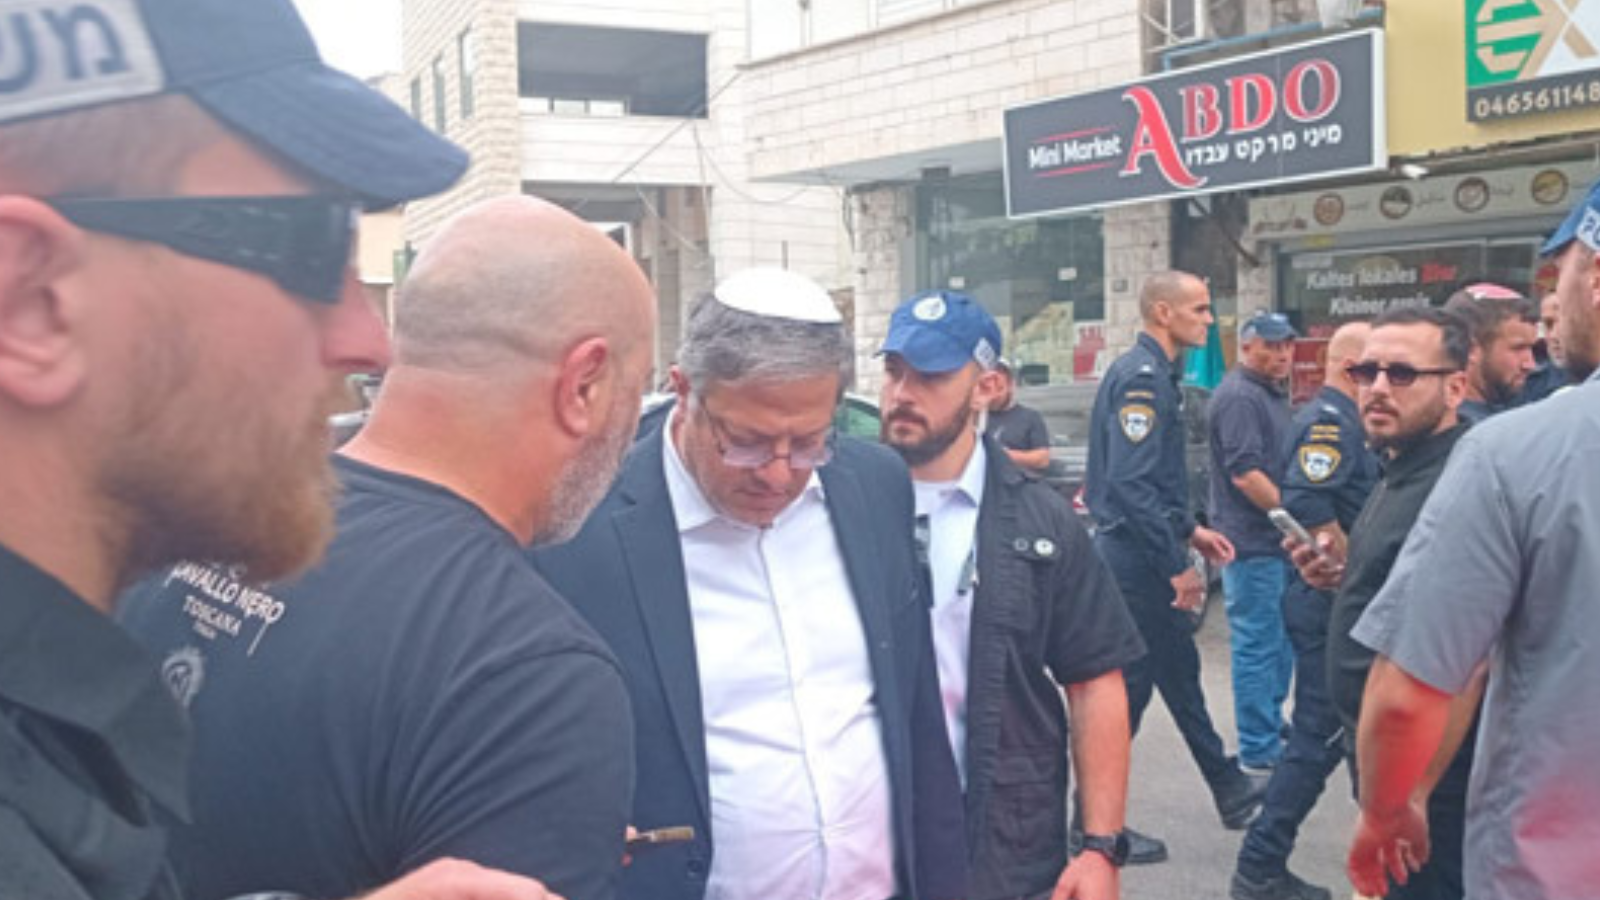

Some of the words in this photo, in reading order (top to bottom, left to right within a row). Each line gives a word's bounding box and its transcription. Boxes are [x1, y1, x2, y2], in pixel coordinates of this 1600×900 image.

[1119, 59, 1342, 189] ABDO
[1303, 124, 1341, 147] מיני
[1029, 142, 1059, 169] Mini
[1063, 133, 1122, 164] Market
[1185, 143, 1229, 166] עבדו
[183, 595, 242, 637] TOSCANA
[235, 587, 285, 624] NERO
